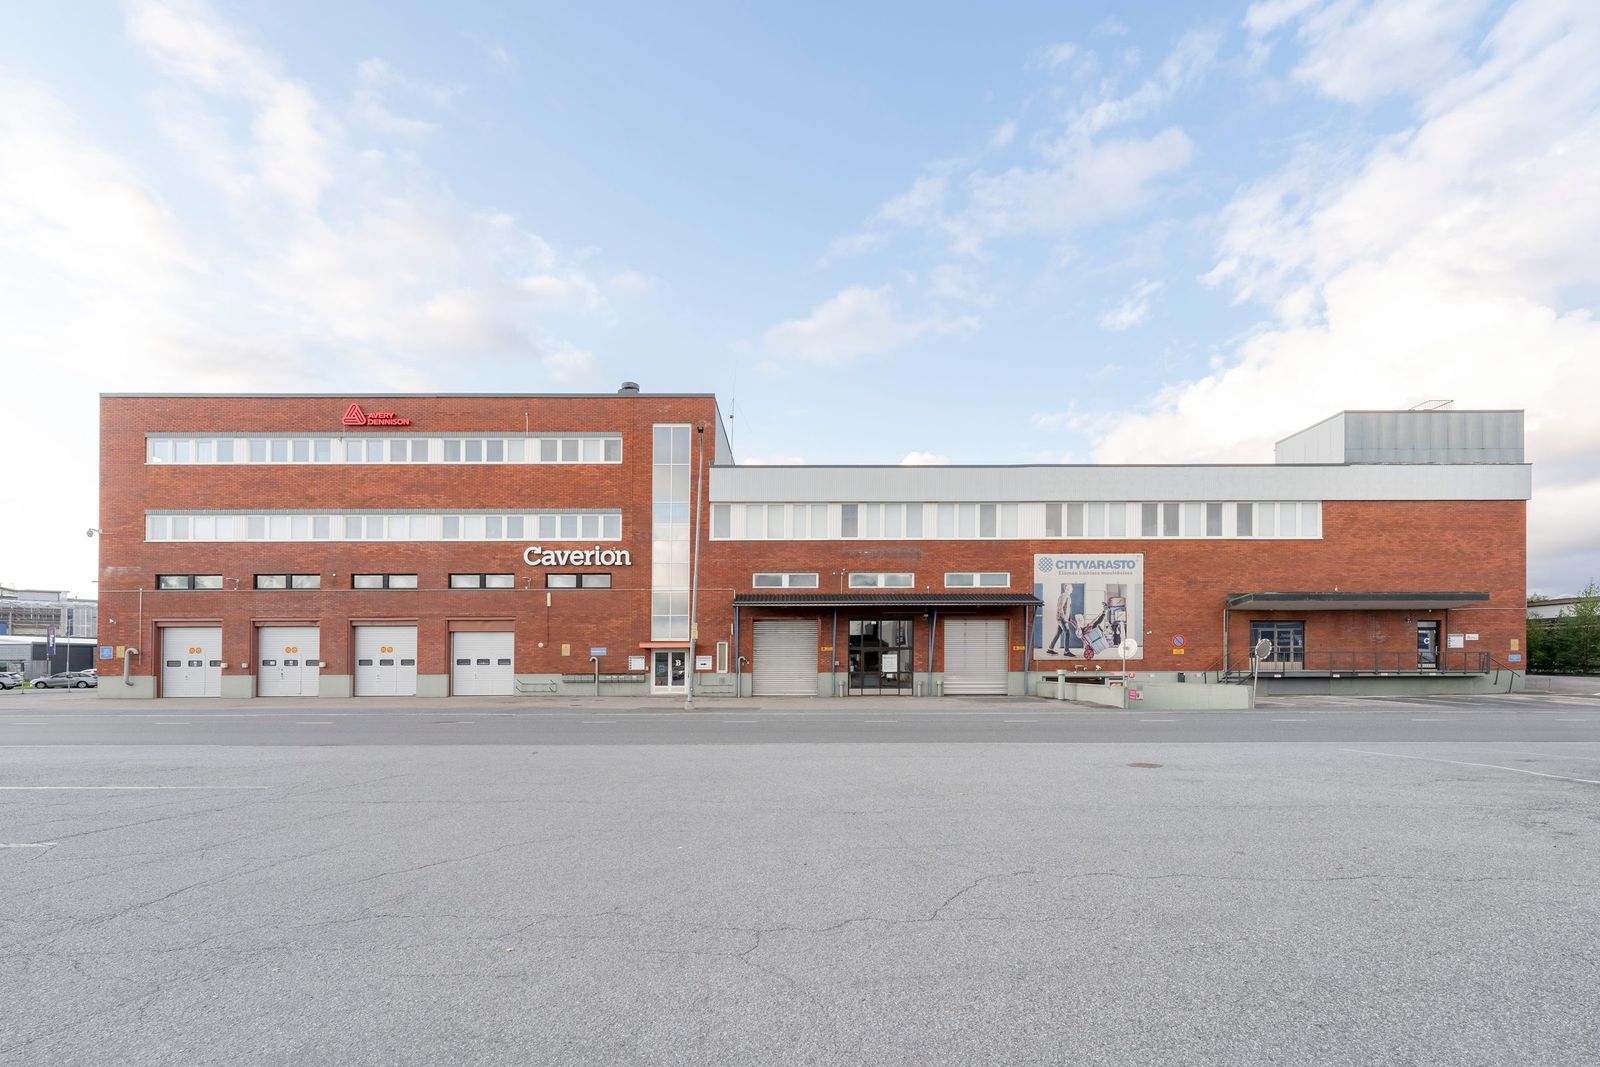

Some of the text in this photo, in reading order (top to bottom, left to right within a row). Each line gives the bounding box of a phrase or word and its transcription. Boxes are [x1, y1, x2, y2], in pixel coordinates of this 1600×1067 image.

[523, 545, 632, 566] Caverion
[1055, 560, 1136, 570] CITYVARASTO
[1423, 637, 1430, 645] C
[675, 659, 682, 667] B
